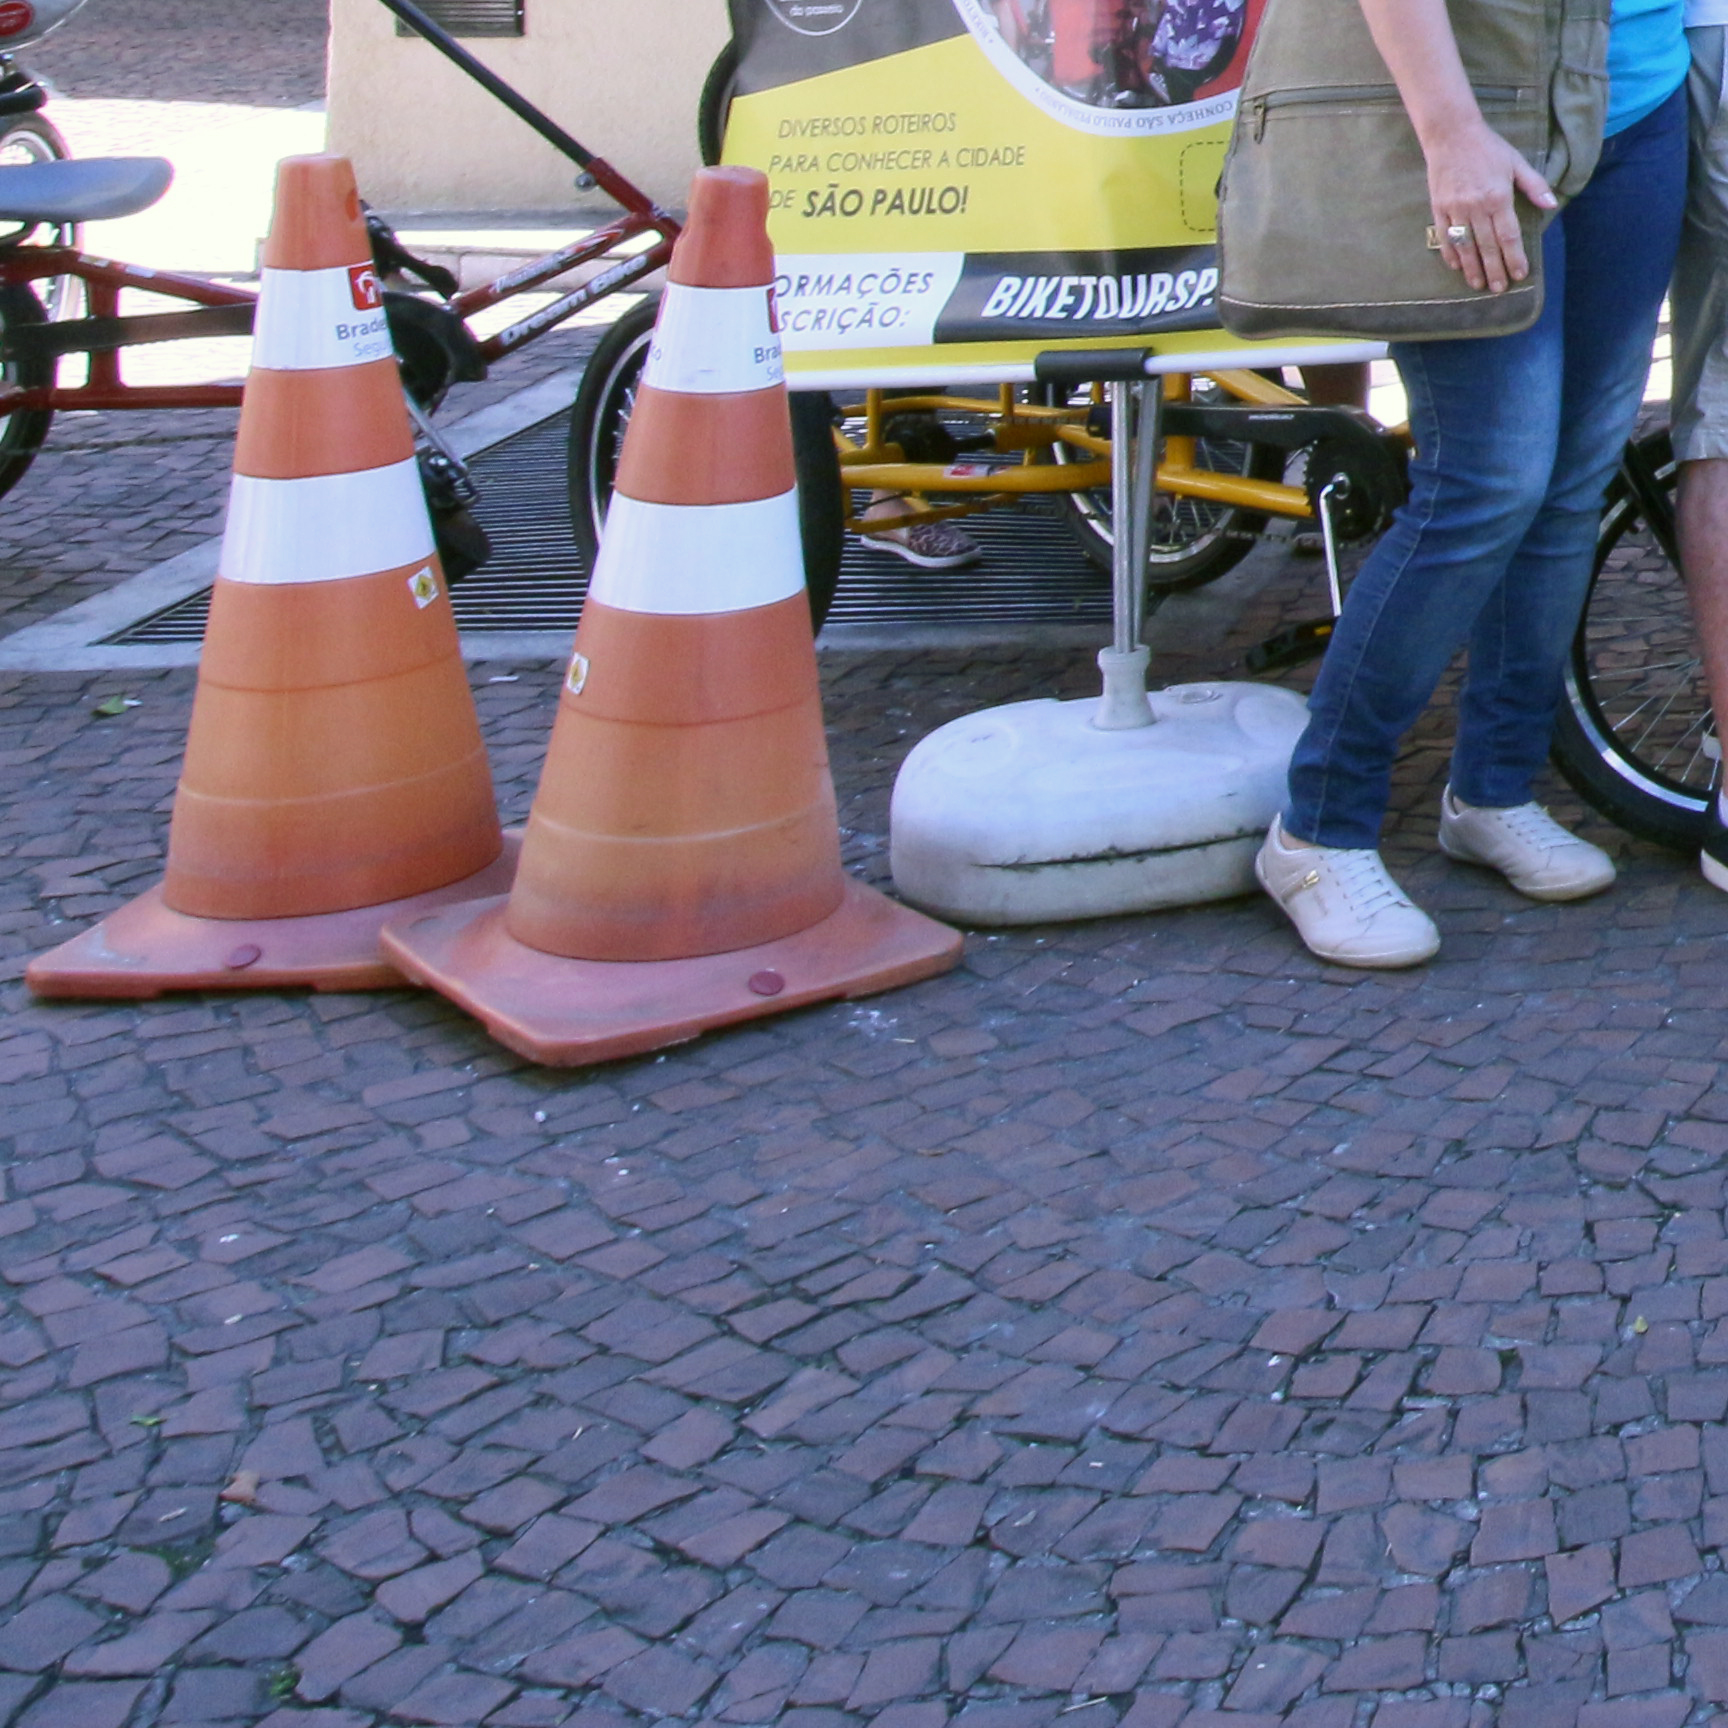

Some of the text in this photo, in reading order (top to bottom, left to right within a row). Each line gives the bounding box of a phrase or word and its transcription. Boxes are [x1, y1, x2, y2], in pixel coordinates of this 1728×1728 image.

[777, 112, 957, 139] DIVERSOS ROTEIROS
[1092, 116, 1131, 128] PAULO
[1136, 115, 1164, 130] SÃO
[1167, 100, 1233, 125] CONHEÇA
[768, 145, 1026, 173] PARA CONHECER A CIDADE
[768, 182, 970, 218] DE SÃO PAULO!
